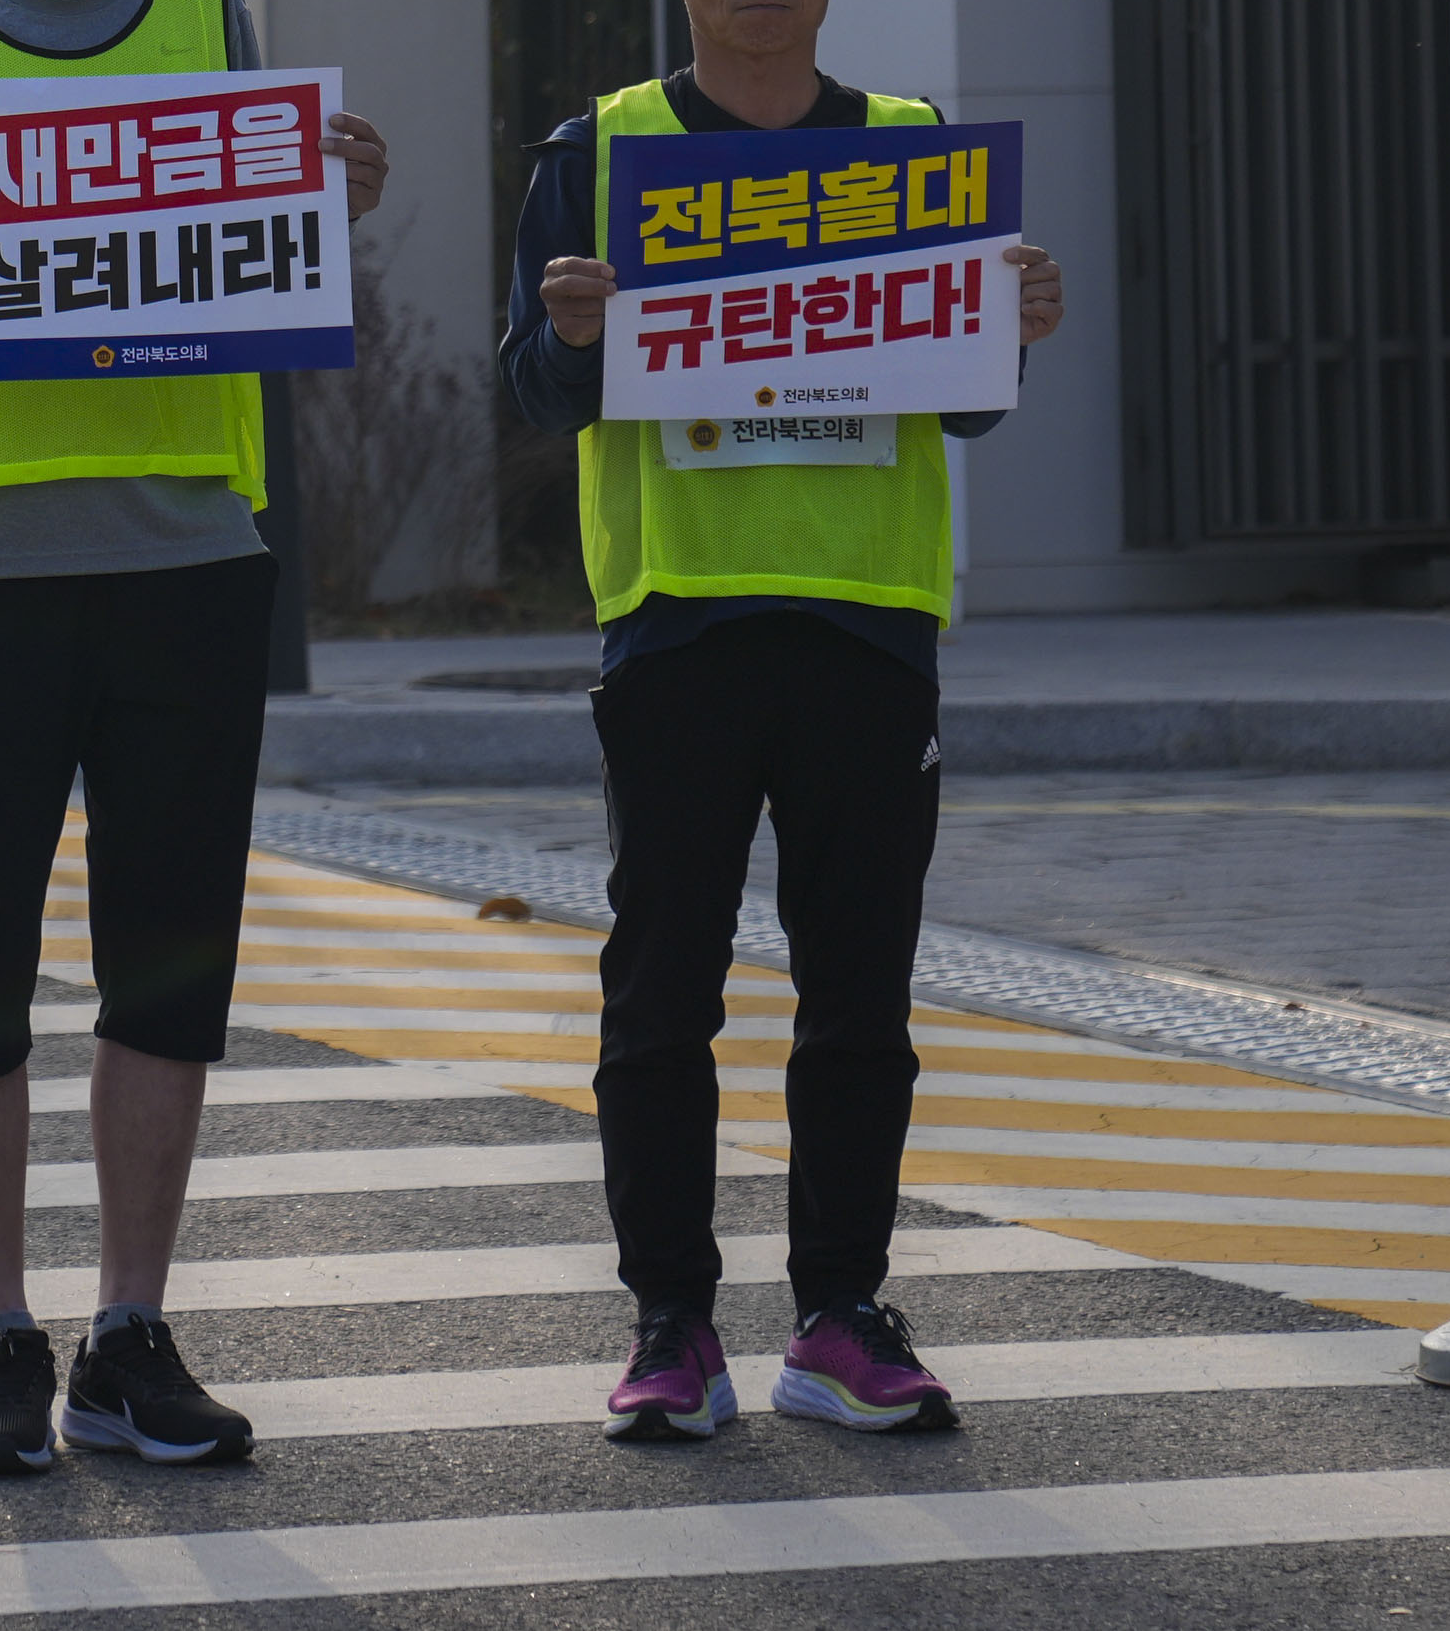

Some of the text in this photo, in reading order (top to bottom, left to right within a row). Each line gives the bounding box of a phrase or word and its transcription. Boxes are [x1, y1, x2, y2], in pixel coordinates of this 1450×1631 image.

[639, 147, 988, 265] 전북홀대
[638, 258, 982, 372] 규탄한다!
[121, 344, 208, 364] 전라북도의회
[783, 386, 869, 405] 전라북도의회
[731, 418, 863, 444] 전라북도의회
